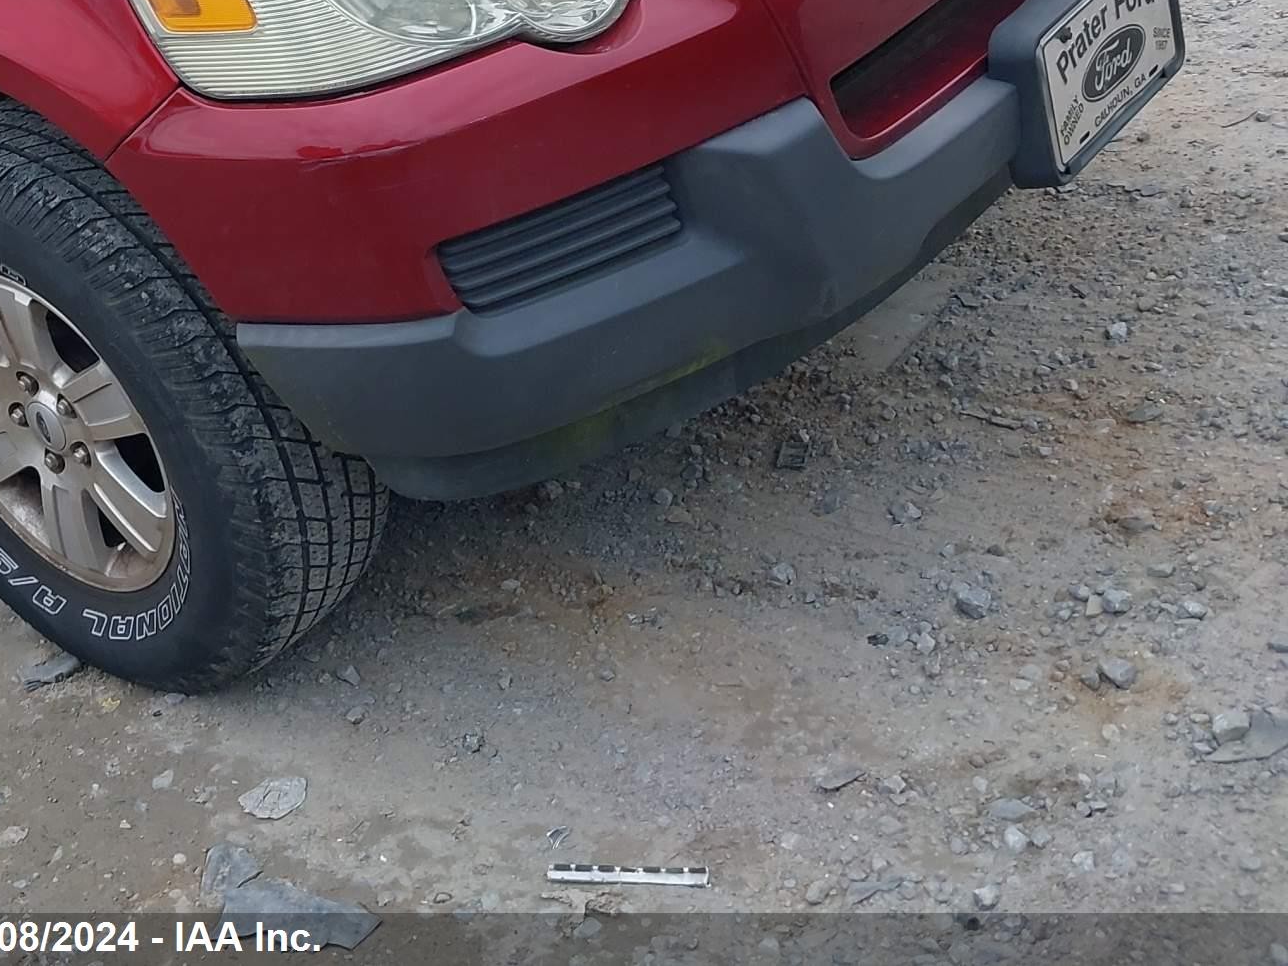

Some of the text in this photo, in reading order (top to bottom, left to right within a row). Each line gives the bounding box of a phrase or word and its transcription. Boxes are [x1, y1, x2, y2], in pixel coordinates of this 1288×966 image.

[1056, 4, 1108, 86] Prater
[1094, 37, 1133, 92] Ford
[1134, 73, 1148, 89] GA
[1060, 95, 1079, 136] FAMILY
[1064, 102, 1084, 145] OWNED
